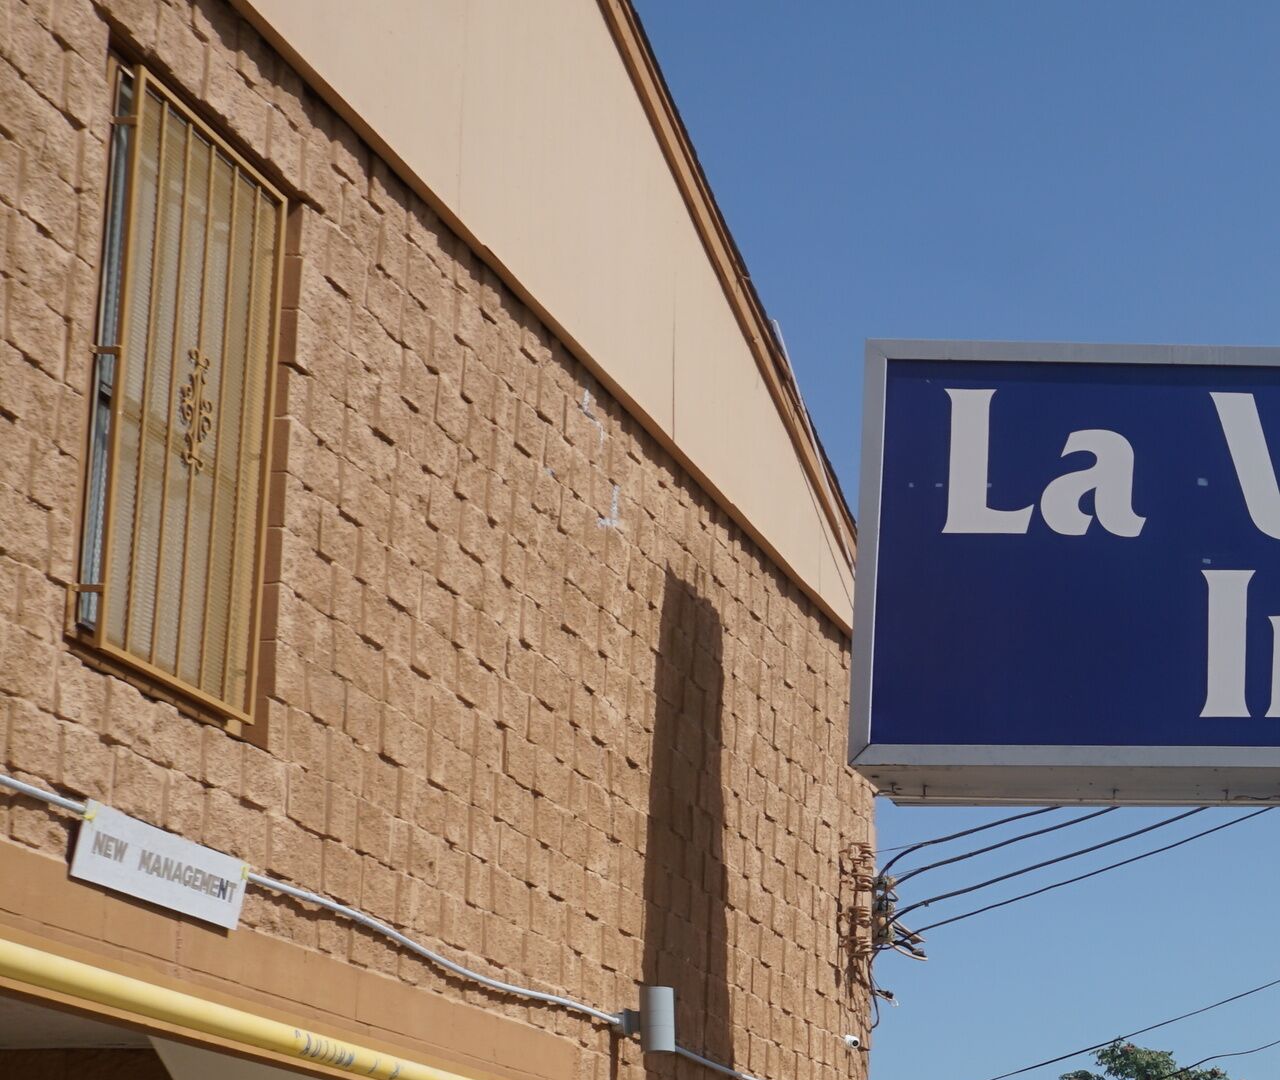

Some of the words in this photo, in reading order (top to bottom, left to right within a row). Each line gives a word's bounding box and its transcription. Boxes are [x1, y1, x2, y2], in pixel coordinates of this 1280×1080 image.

[941, 388, 1147, 538] La
[92, 831, 129, 863] NEW
[137, 850, 238, 903] MANAGEMENT
